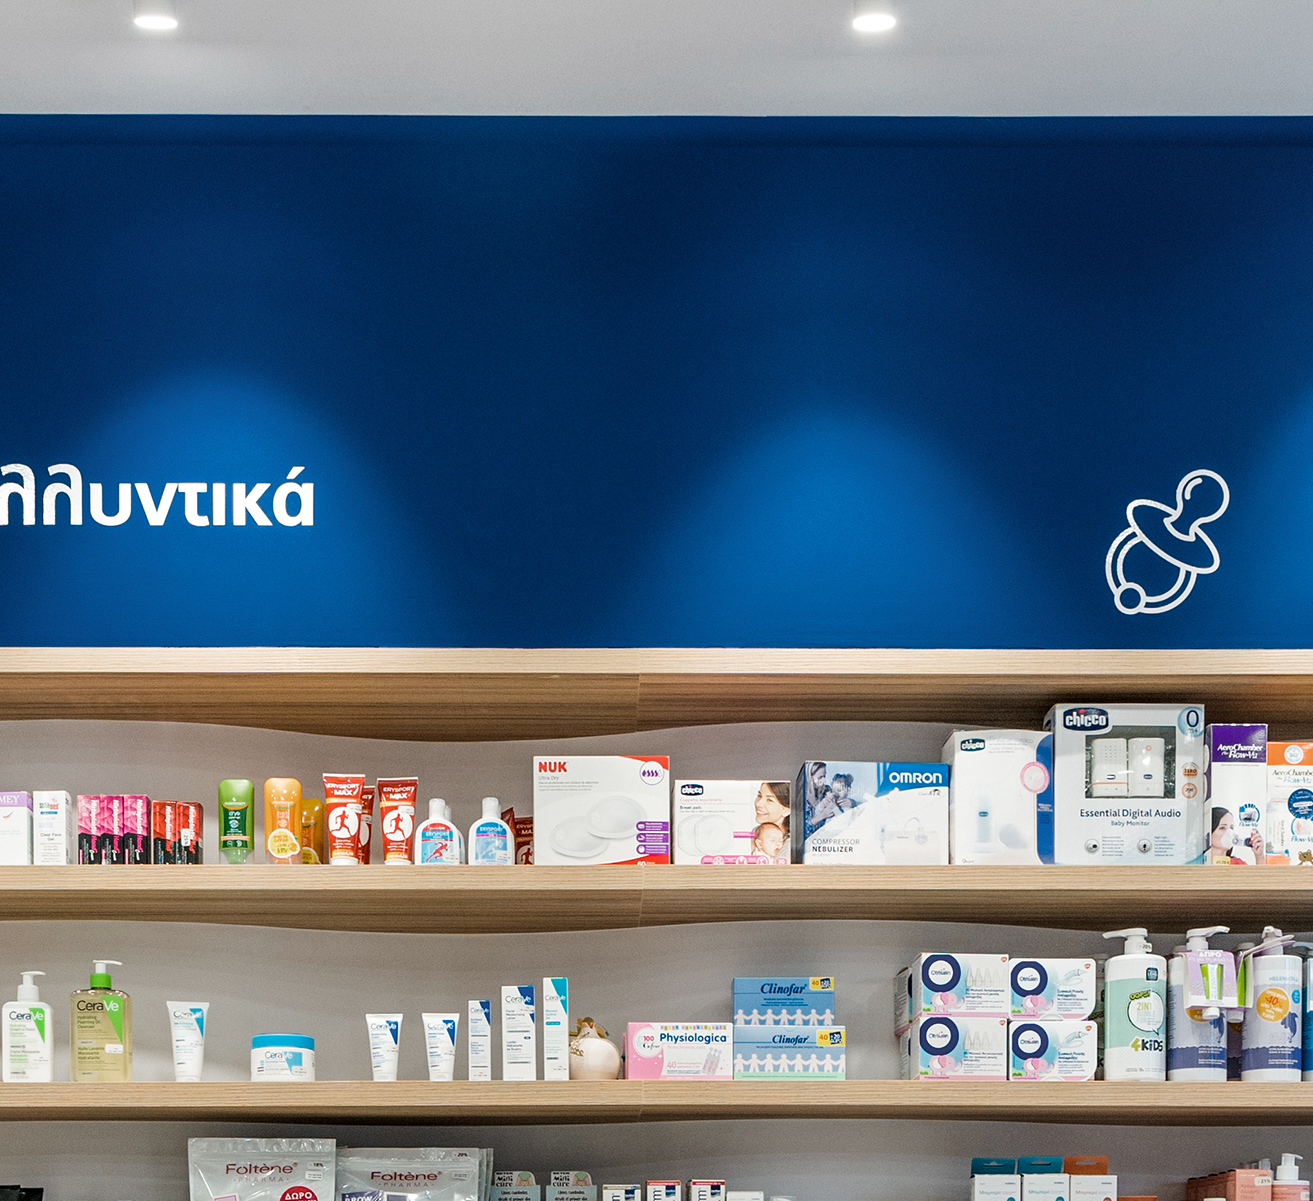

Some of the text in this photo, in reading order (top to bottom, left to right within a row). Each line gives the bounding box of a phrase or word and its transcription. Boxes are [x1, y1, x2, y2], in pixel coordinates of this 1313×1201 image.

[1065, 710, 1107, 728] chicco
[538, 761, 567, 773] NUK
[889, 771, 942, 784] OMRON
[1080, 808, 1181, 820] Essential Digital Audio
[812, 838, 860, 846] COMPRESSOR
[812, 845, 853, 853] NEBULIZER
[760, 982, 806, 996] Clinofar
[76, 999, 119, 1012] CeraVe
[9, 1010, 44, 1021] CeraVe
[173, 1010, 203, 1019] CeraVe
[660, 1032, 728, 1045] Physiologica
[772, 1033, 809, 1046] Clinofar
[225, 1162, 293, 1175] Foltène
[371, 1170, 438, 1182] Foltène
[284, 1191, 313, 1201] ΔΩΡΟ
